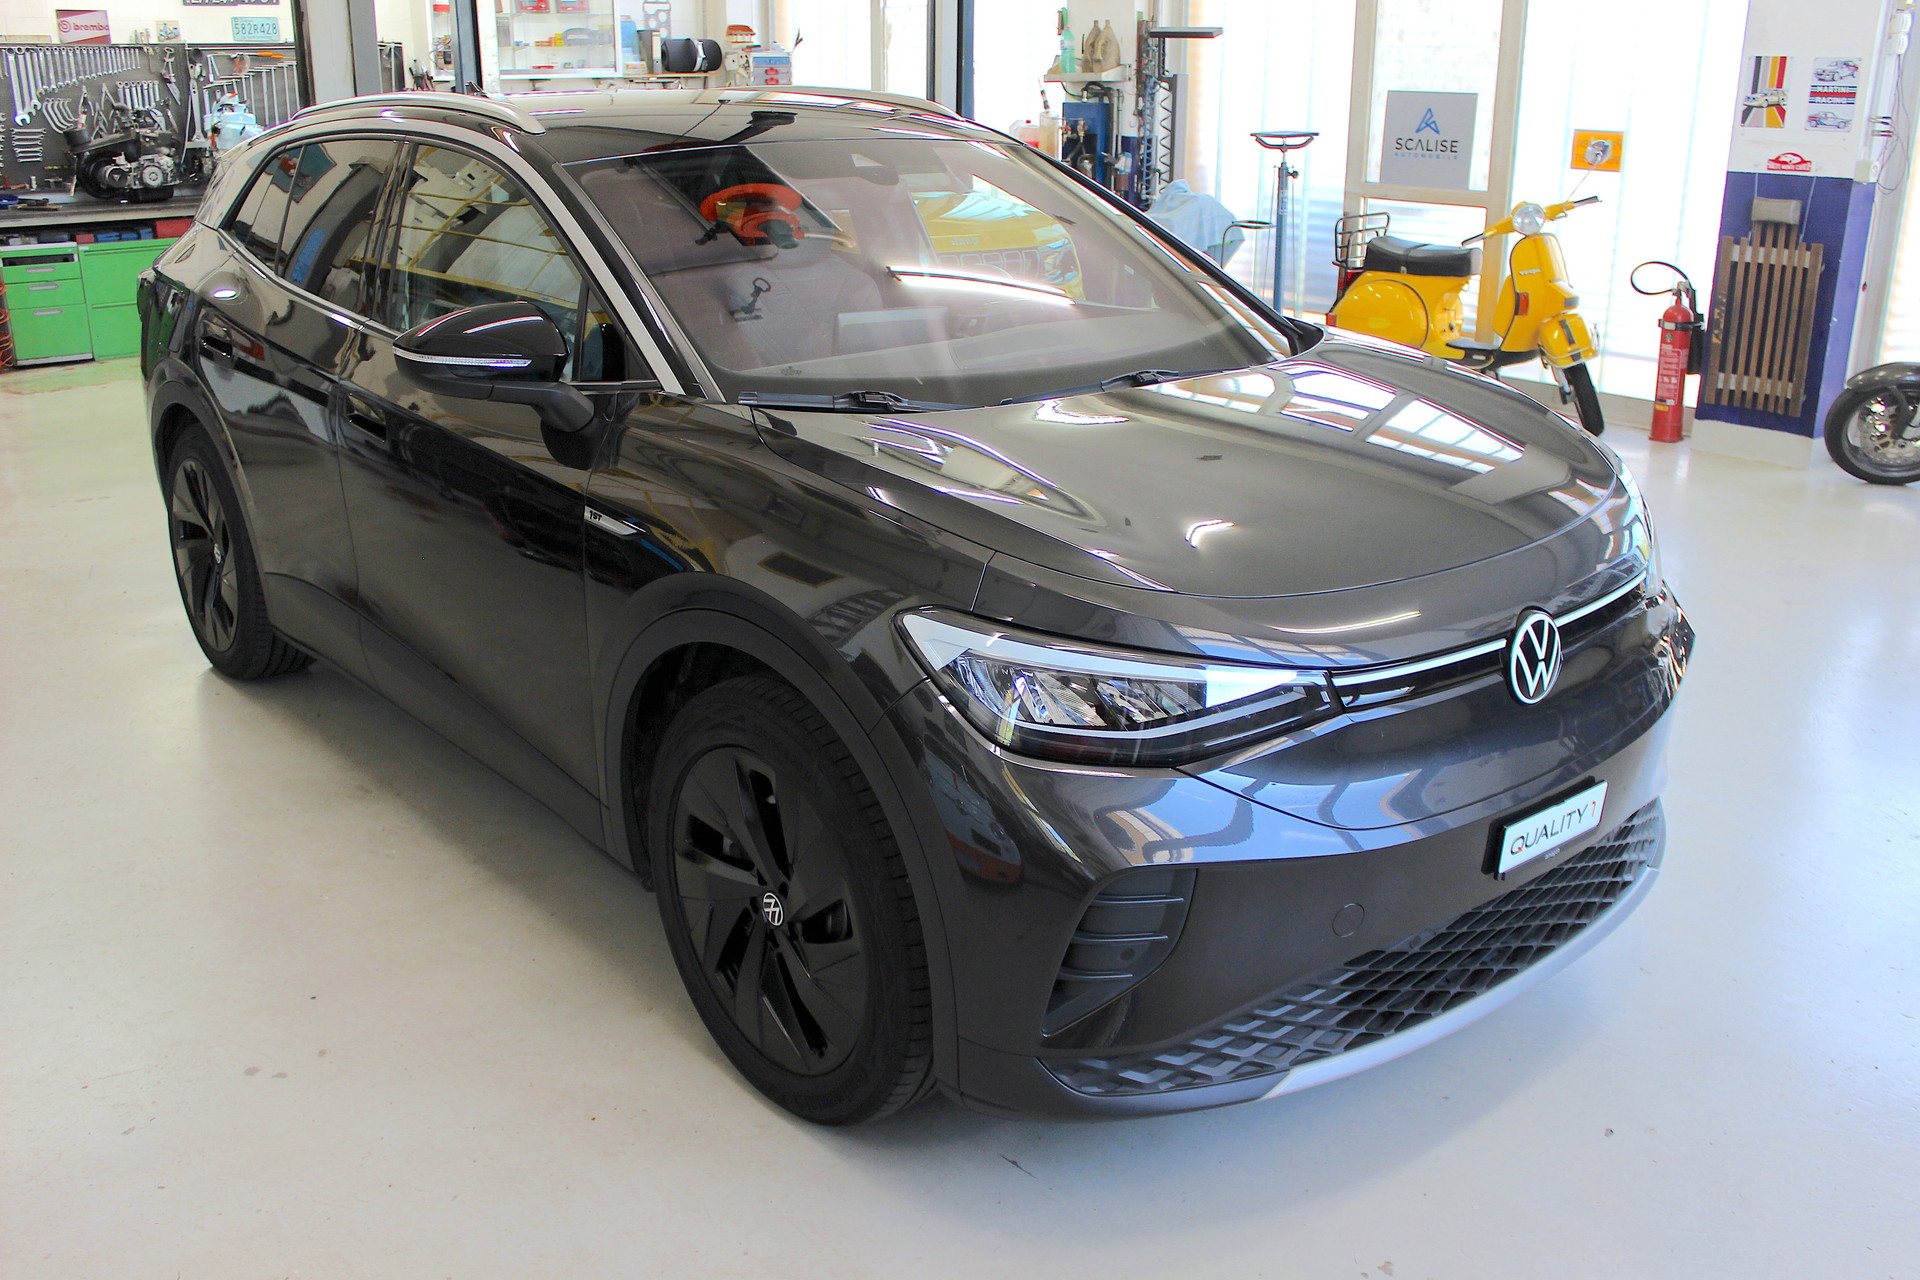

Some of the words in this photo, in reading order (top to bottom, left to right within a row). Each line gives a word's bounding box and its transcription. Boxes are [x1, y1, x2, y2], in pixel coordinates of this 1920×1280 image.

[73, 22, 109, 31] brembo
[234, 22, 278, 36] 582R428
[1395, 137, 1459, 153] SCALISE
[589, 510, 603, 521] 1ST
